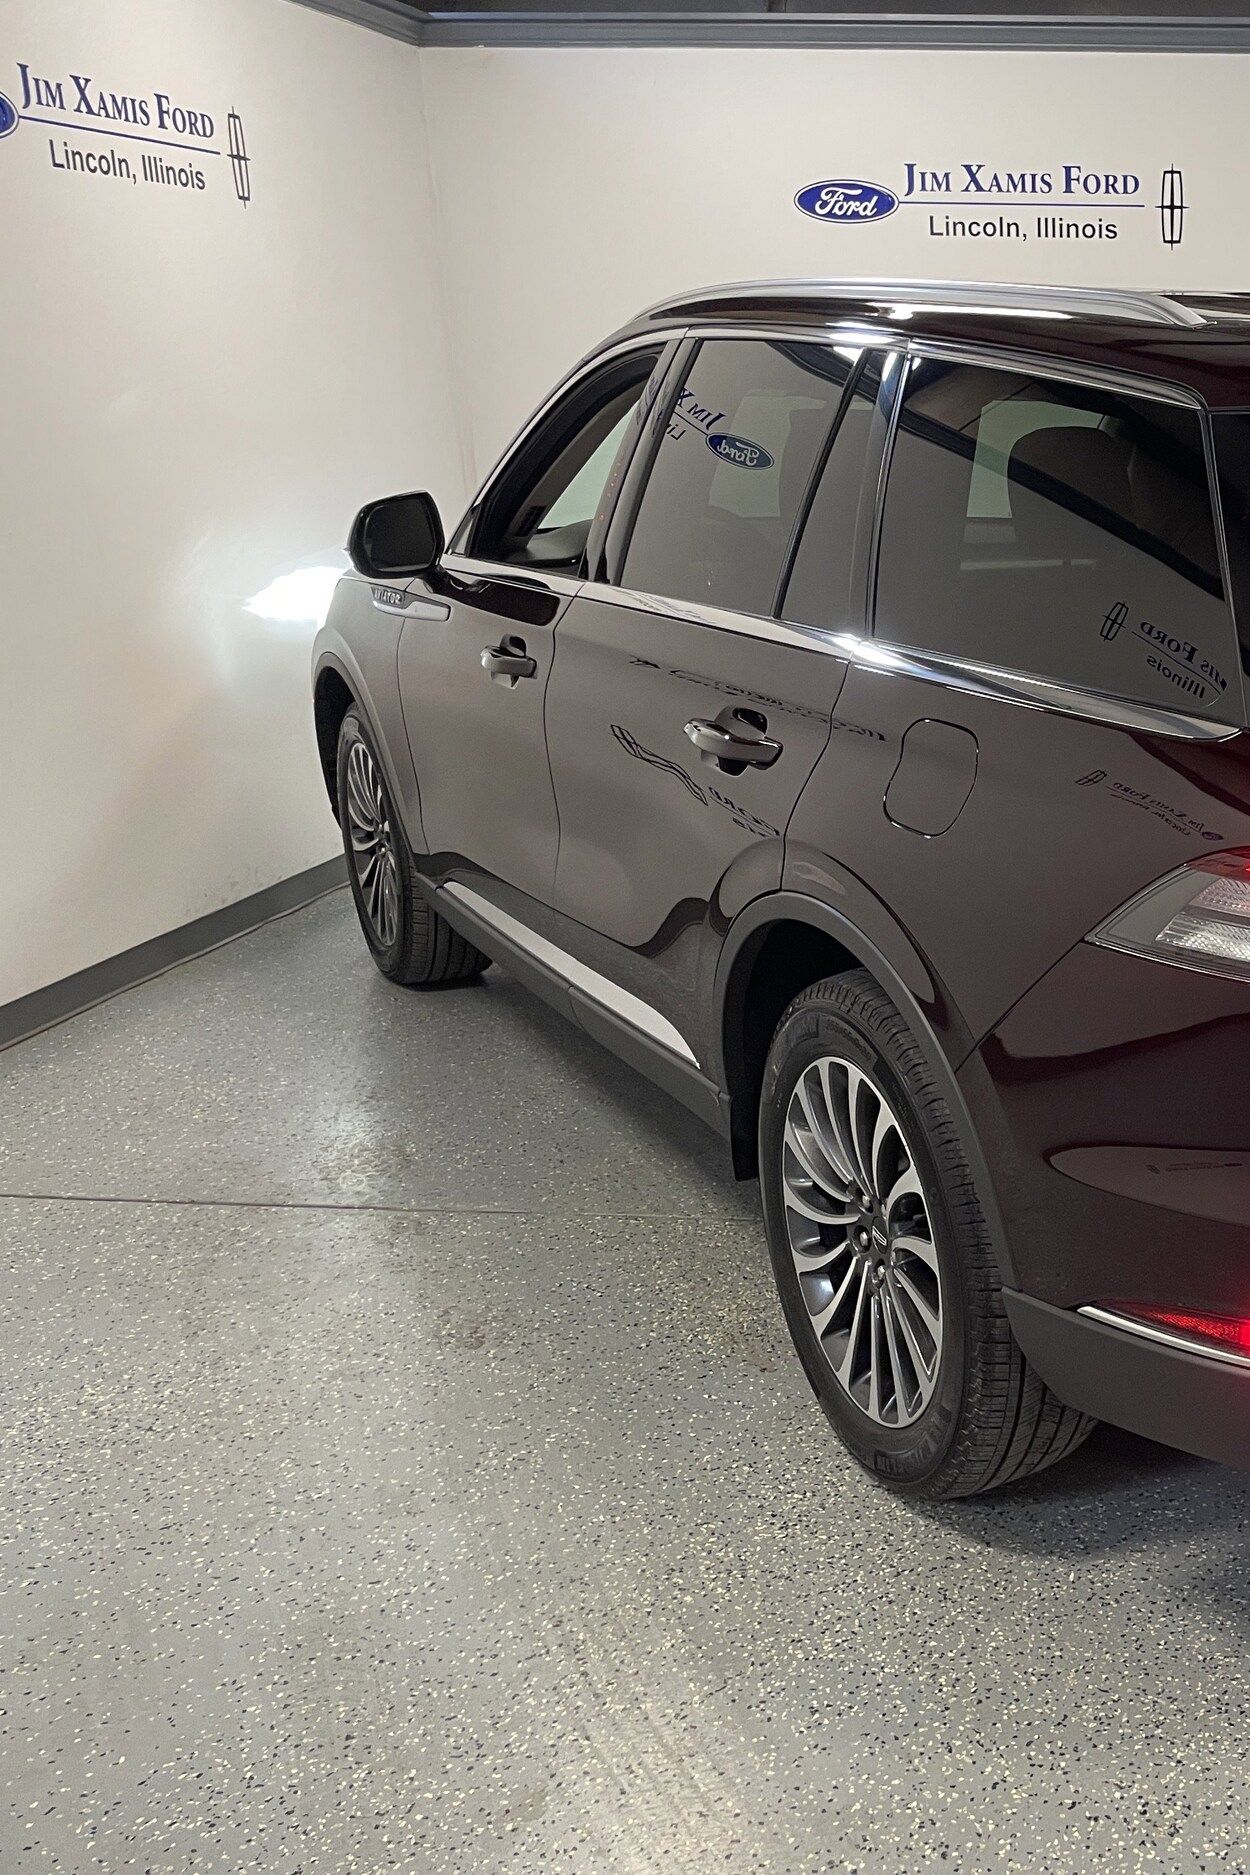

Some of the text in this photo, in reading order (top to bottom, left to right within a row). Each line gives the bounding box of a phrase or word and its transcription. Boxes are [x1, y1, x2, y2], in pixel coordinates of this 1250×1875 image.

[16, 62, 215, 139] JIM XAMIS FORD
[48, 139, 206, 191] Lincoln, Illinois
[904, 163, 1140, 197] JIM XAMIS FORD
[814, 187, 878, 219] Ford
[929, 216, 1118, 242] Lincoln, Illinois
